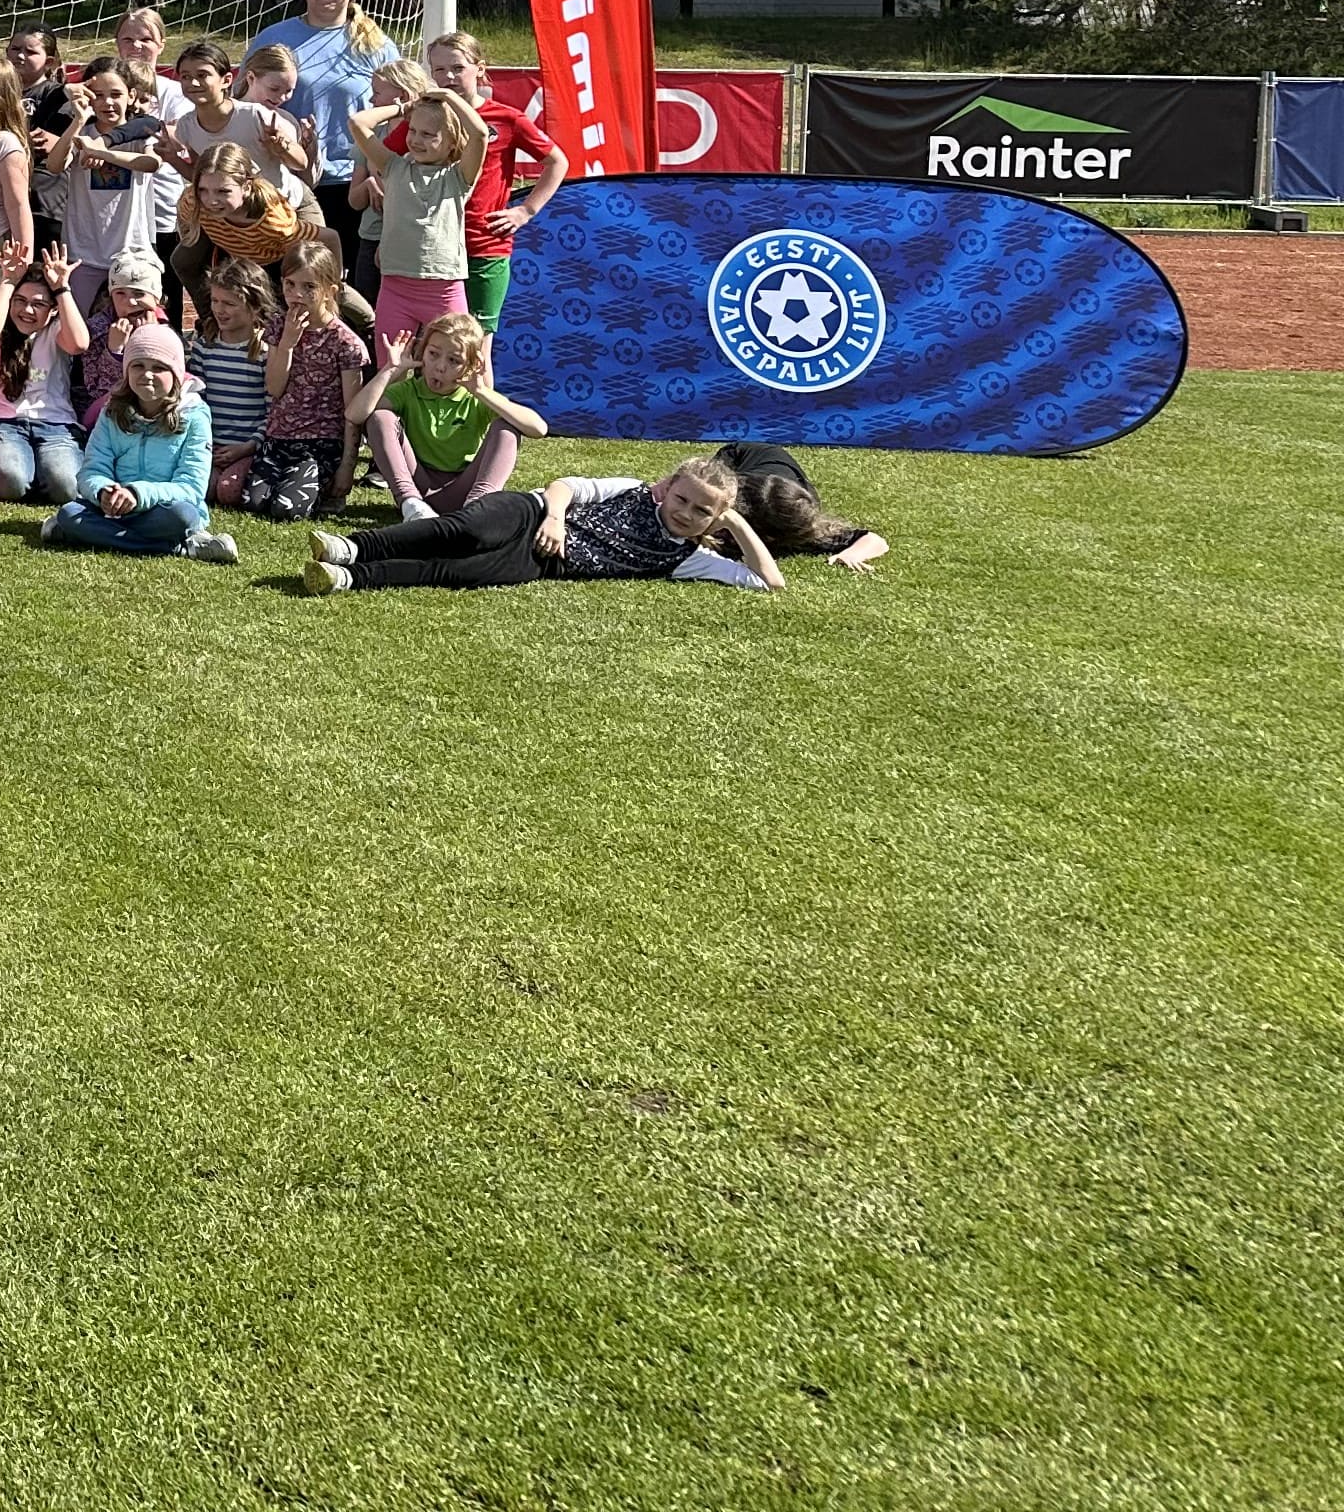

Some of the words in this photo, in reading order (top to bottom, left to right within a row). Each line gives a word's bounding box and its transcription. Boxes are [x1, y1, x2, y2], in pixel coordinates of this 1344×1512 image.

[927, 134, 1132, 180] Rainter
[746, 240, 843, 271] EESTI
[719, 284, 851, 382] JALGPALLI
[846, 289, 875, 351] LIIT
